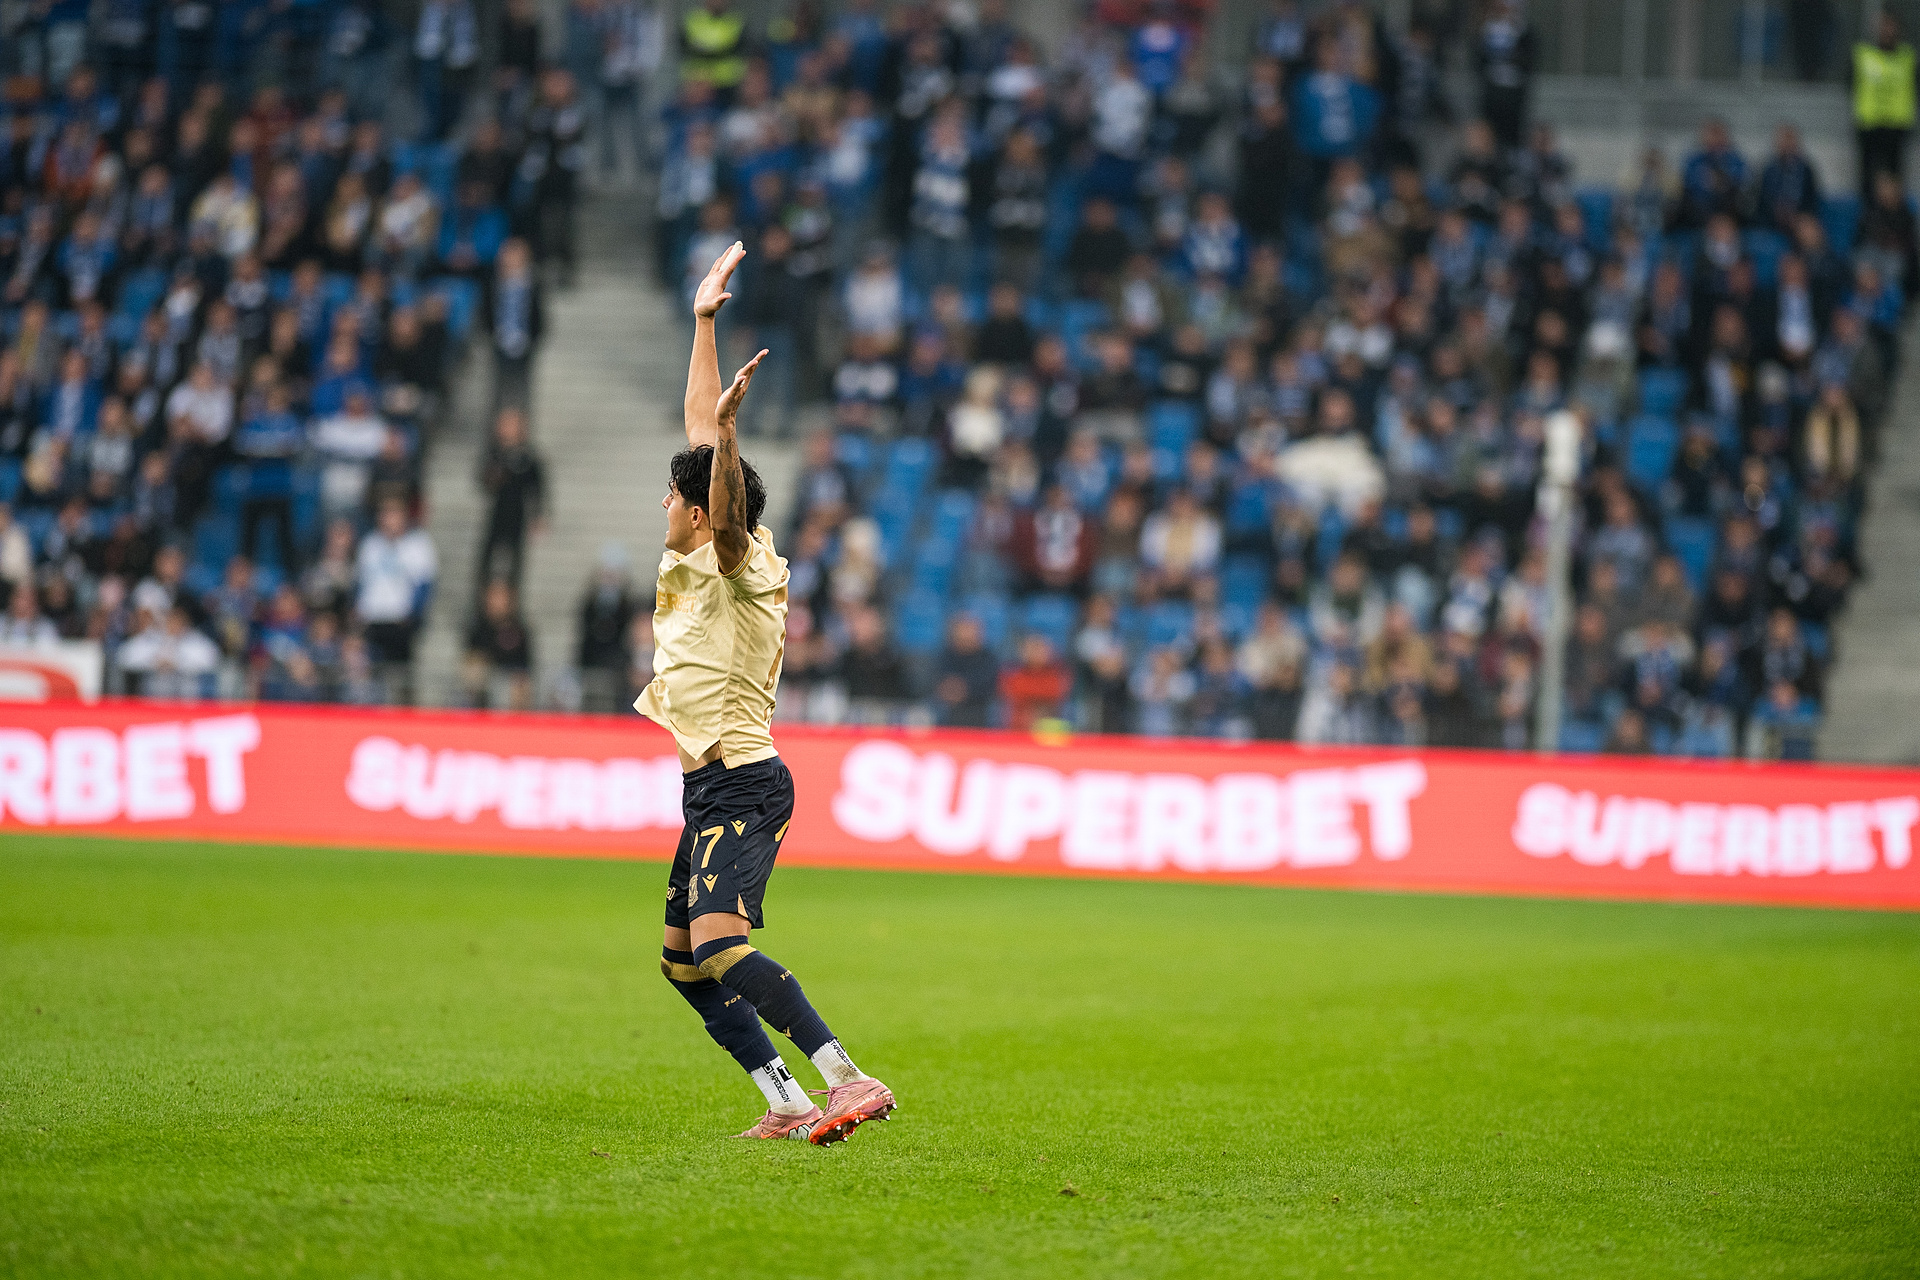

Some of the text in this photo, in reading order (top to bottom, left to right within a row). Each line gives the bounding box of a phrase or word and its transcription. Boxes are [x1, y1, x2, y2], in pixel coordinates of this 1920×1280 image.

[0, 713, 262, 826] RBET
[346, 735, 687, 831] SUPERBE
[833, 739, 1427, 872] SUPERBET
[1512, 782, 1919, 877] SUPERBET
[769, 1070, 791, 1103] TAPEDESIGN
